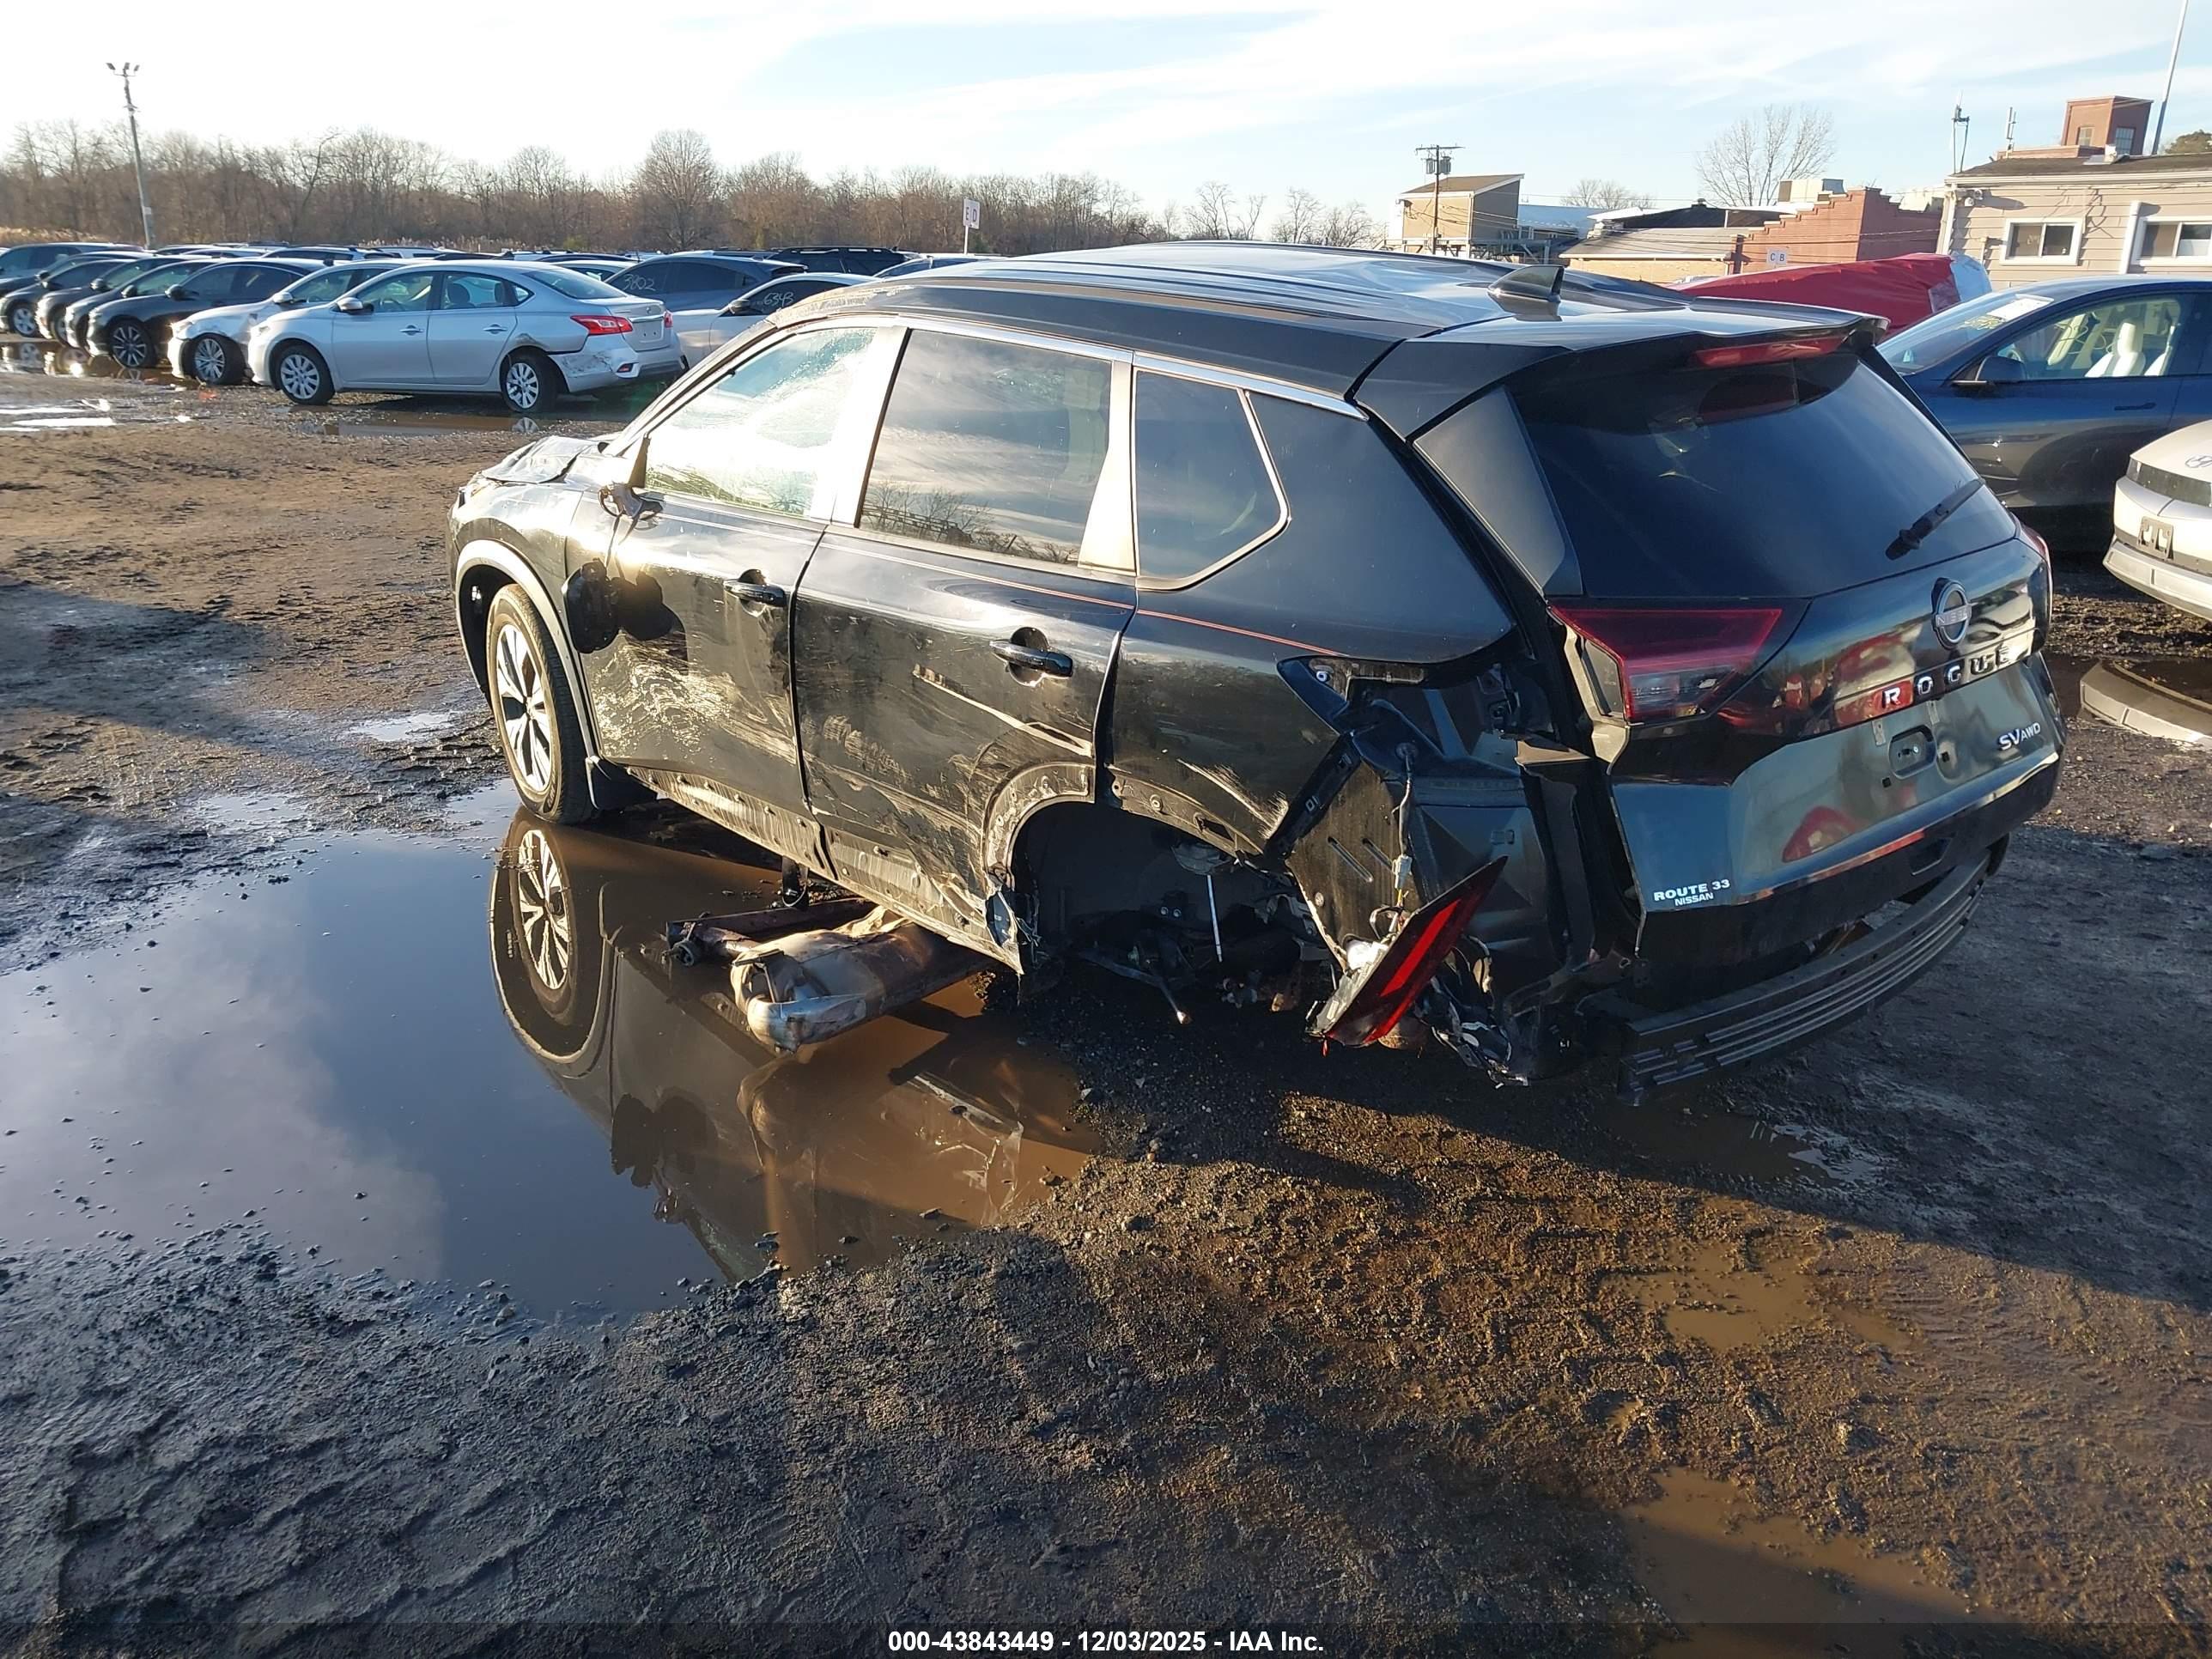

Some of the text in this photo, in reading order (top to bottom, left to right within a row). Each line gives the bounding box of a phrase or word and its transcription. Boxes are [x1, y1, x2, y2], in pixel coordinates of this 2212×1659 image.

[972, 209, 977, 222] D
[1770, 252, 1785, 262] C B
[1881, 642, 2012, 709] ROGUE
[2021, 722, 2041, 742] AWD
[1653, 878, 1730, 902] ROUTE 33
[1674, 892, 1714, 906] NISSAN
